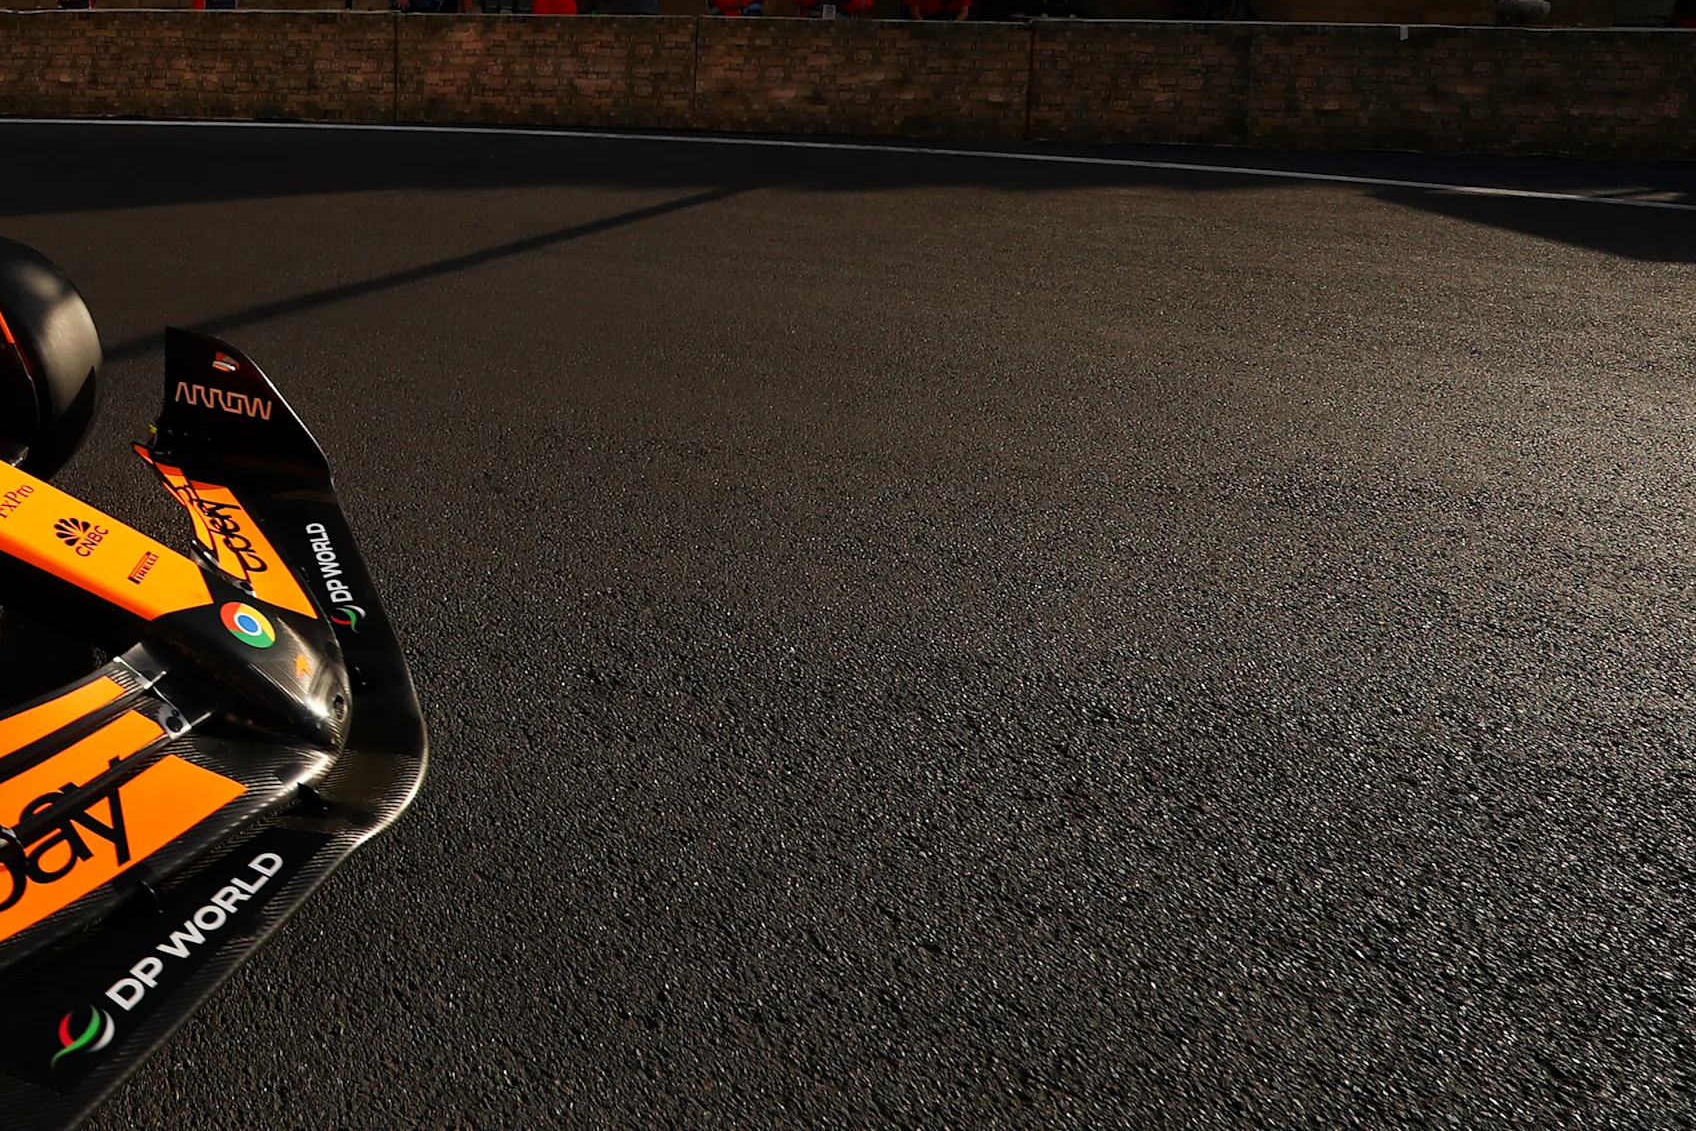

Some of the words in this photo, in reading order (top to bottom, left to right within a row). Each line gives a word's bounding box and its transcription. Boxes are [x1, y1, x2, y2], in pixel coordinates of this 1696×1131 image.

[75, 524, 110, 558] CNBC
[304, 521, 344, 579] WORLD
[126, 550, 161, 586] PIRELLI
[324, 578, 355, 604] DP
[104, 956, 165, 1012] DP
[154, 852, 285, 960] WORLD
